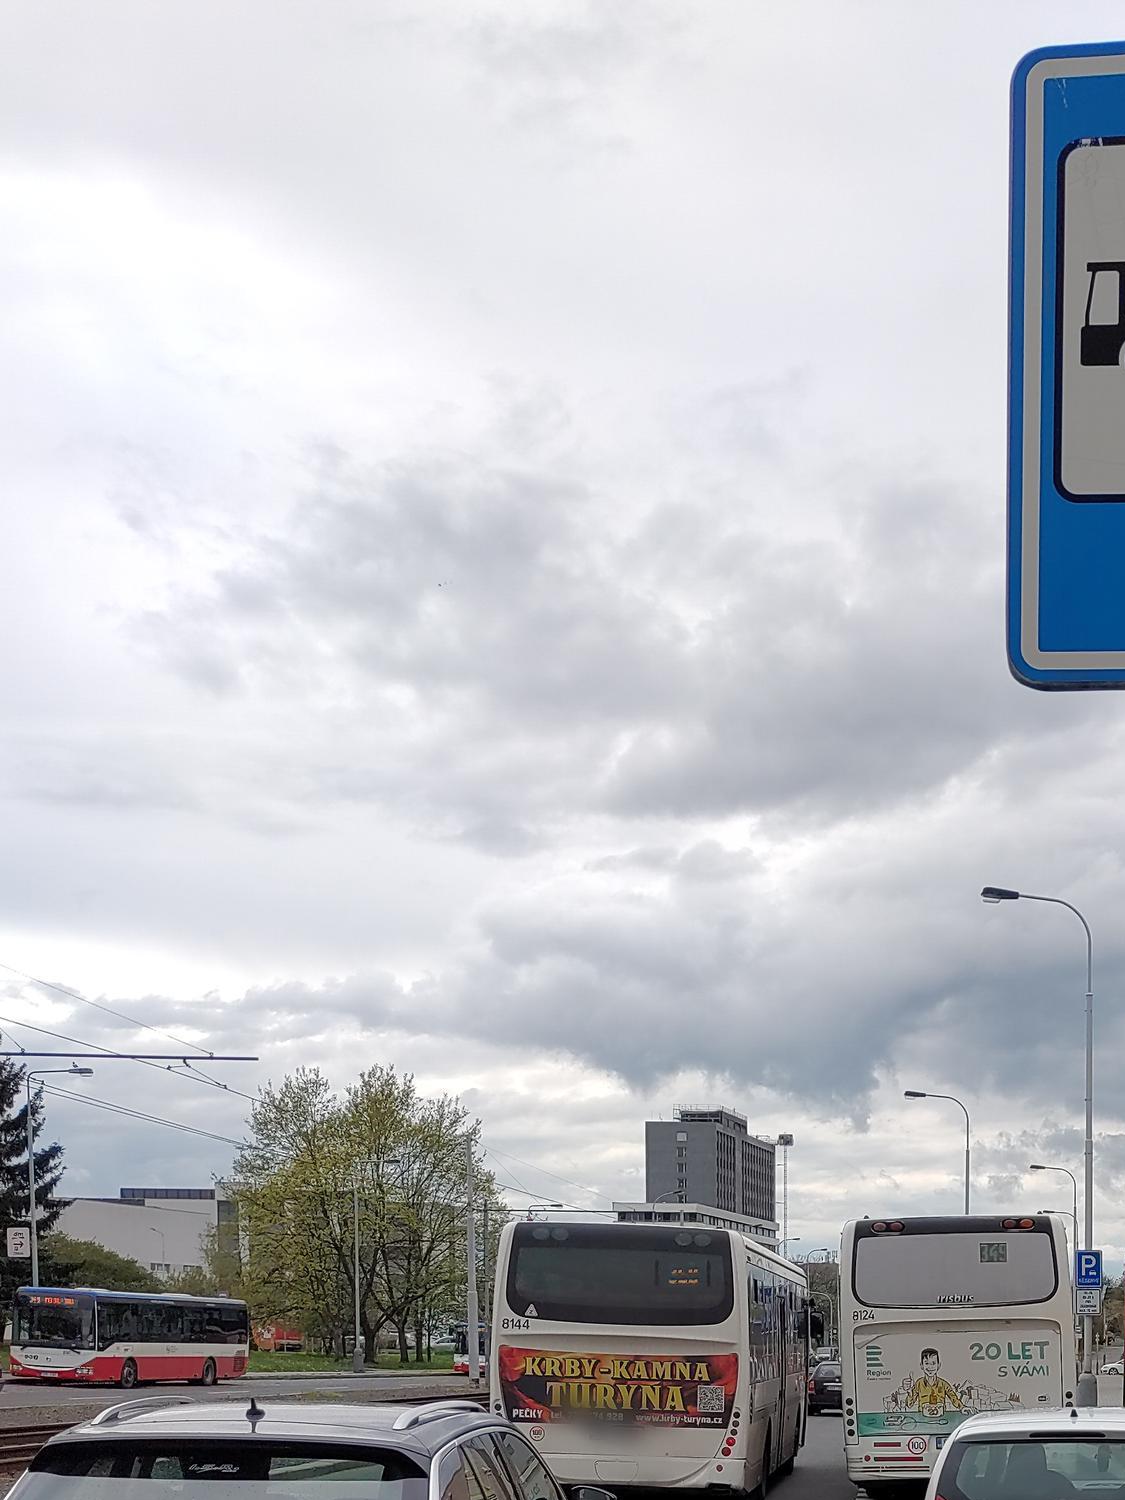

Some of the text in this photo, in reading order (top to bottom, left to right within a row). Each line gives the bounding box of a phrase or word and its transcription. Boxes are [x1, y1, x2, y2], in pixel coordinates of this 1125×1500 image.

[1082, 1255, 1097, 1276] P
[852, 1309, 875, 1321] 8124
[501, 1318, 531, 1330] 8144
[969, 1341, 1050, 1361] 20 LET
[523, 1355, 711, 1382] KRBY-KAMNA
[866, 1369, 892, 1377] Region
[997, 1362, 1050, 1377] S VÁMI
[546, 1382, 687, 1411] TURYNA
[512, 1407, 544, 1419] PEČKY
[911, 1442, 924, 1450] 100
